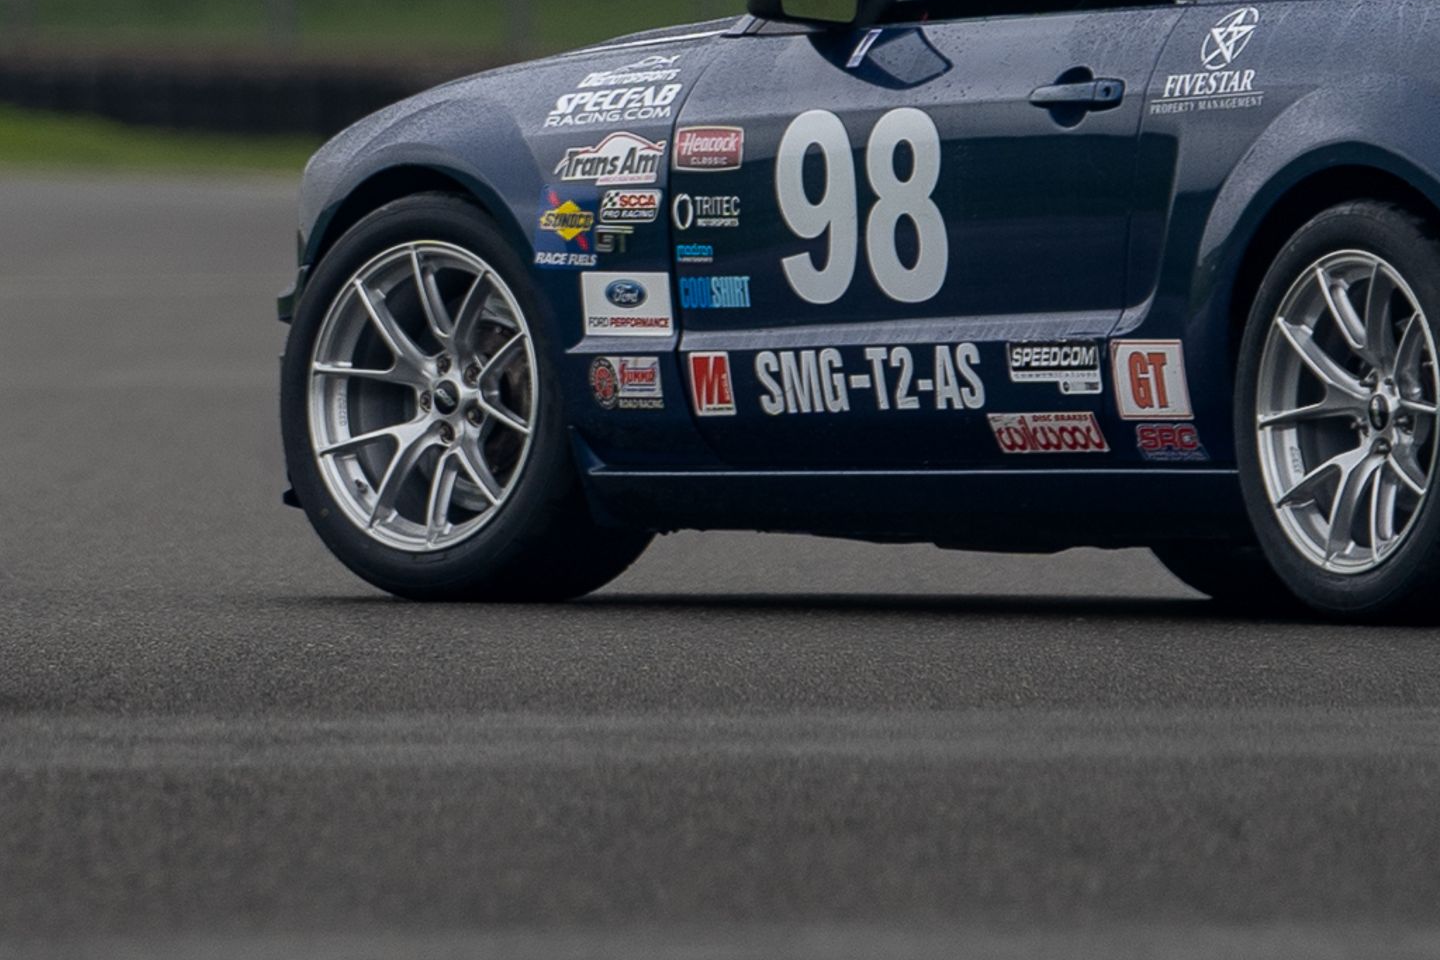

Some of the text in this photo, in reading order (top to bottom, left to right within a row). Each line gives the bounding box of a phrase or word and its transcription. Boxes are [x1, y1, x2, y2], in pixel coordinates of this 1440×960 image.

[1162, 69, 1256, 98] FIVESTAR
[548, 83, 683, 116] SPECFAB
[1149, 96, 1264, 115] PROPERTY MANAGEMENT
[543, 106, 672, 129] RACING.COM
[680, 132, 739, 156] Heacock
[561, 146, 658, 178] Trans Am
[619, 194, 657, 208] SCCA
[694, 195, 741, 217] TRITEC
[776, 107, 949, 304] 98
[544, 212, 593, 229] SUNOCO
[602, 210, 655, 219] PRO RACING
[534, 251, 598, 267] RACE FUELS
[611, 283, 640, 303] Ford
[588, 316, 670, 329] FORD PERFORMANCE
[1011, 346, 1096, 367] SPEEDCOM
[754, 342, 987, 416] SMG-T2-AS
[1127, 350, 1169, 409] GT
[1032, 413, 1089, 422] DISC BRAKES
[995, 413, 1106, 451] wilwood
[1136, 424, 1199, 450] SRC
